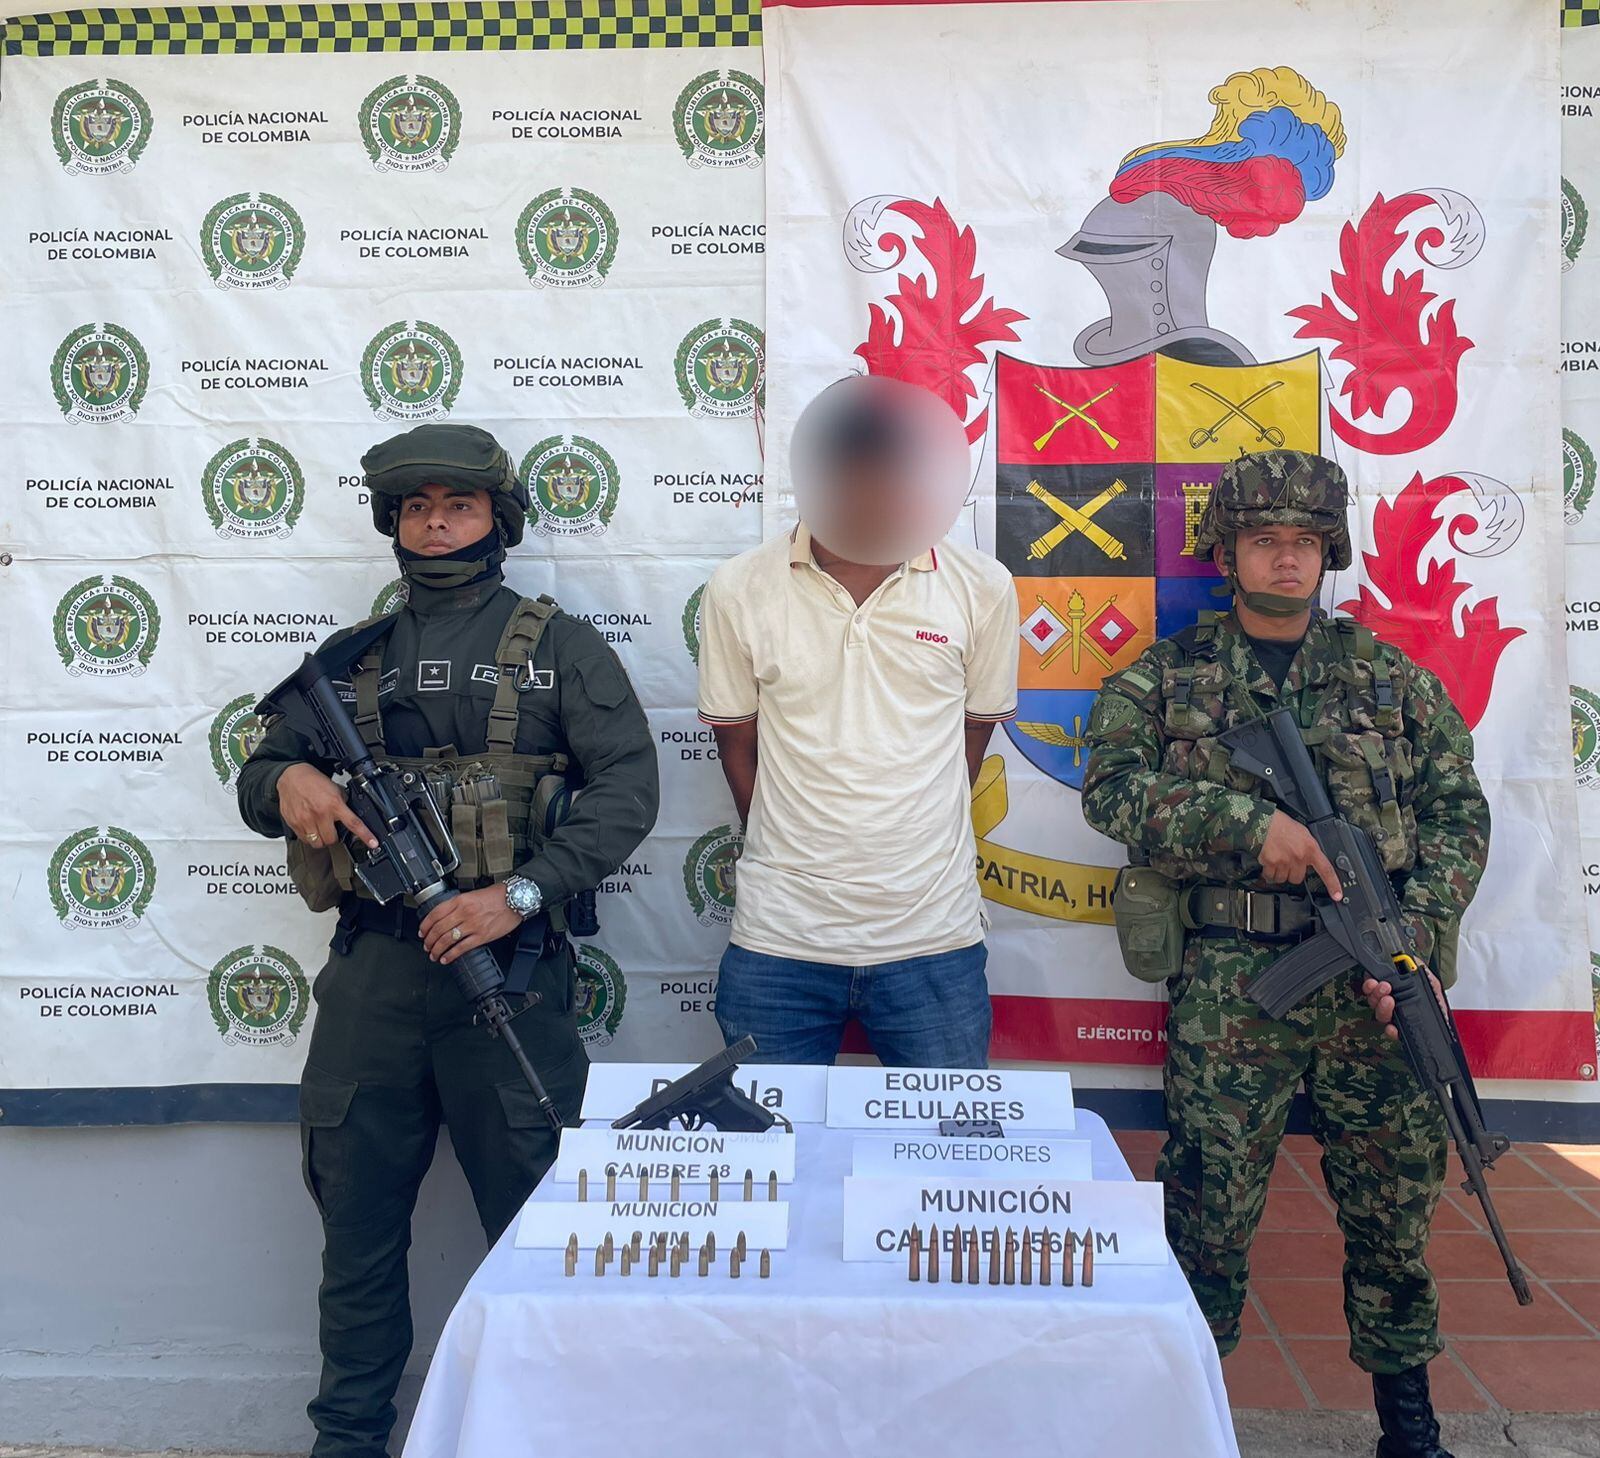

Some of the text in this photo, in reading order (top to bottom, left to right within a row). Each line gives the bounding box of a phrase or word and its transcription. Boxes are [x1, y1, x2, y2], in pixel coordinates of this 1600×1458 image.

[118, 94, 140, 131] COLOMBIA
[426, 91, 449, 128] COLOMBIA
[493, 109, 642, 120] POLICÍA NACIONAL
[184, 111, 328, 126] POLICÍA NACIONAL
[203, 130, 310, 143] DE COLOMBIA
[512, 127, 622, 138] DE COLOMBIA
[100, 139, 134, 163] NACIONAL
[412, 137, 446, 160] NACIONAL
[76, 162, 93, 172] DIOS
[100, 160, 124, 172] PATRIA
[386, 159, 404, 170] DIOS
[412, 159, 437, 170] PATRIA
[270, 208, 293, 246] COLOMBIA
[582, 203, 606, 243] COLOMBIA
[652, 223, 766, 237] POLICÍA NACIO
[30, 228, 173, 243] POLICÍA NACIONAL
[341, 227, 488, 240] POLICÍA NACIONAL
[48, 248, 156, 260] DE COLOMBIA
[360, 246, 469, 257] DE COLOMBIA
[672, 243, 765, 254] DE COLOMB
[253, 254, 288, 278] NACIONAL
[568, 252, 602, 276] NACIONAL
[227, 276, 244, 287] DIOS
[253, 276, 278, 288] PATRIA
[541, 275, 559, 286] DIOS
[568, 273, 593, 286] PATRIA
[426, 336, 450, 376] COLOMBIA
[494, 356, 643, 369] POLICÍA NACIONAL
[182, 357, 328, 372] POLICÍA NACIONAL
[202, 377, 308, 389] DE COLOMBIA
[514, 375, 623, 386] DE COLOMBIA
[412, 385, 446, 409] NACIONAL
[386, 407, 404, 418] DIOS
[412, 408, 437, 419] PATRIA
[268, 454, 293, 494] COLOMBIA
[654, 471, 716, 485] POLICÍA
[27, 477, 174, 491] POLICÍA NACIONAL
[46, 496, 156, 508] DE COLOMBIA
[674, 492, 764, 503] DE COLOMB
[255, 502, 291, 527] NACIONAL
[228, 525, 246, 536] DIOS
[255, 525, 281, 537] PATRIA
[123, 592, 147, 632] COLOMBIA
[189, 611, 338, 625] POLICÍA NACIONAL
[572, 614, 651, 625] ACIONAL
[206, 632, 316, 642] DE COLOMBIA
[916, 630, 948, 644] HUGO
[107, 640, 143, 665] NACIONAL
[78, 663, 98, 674] DIOS
[106, 663, 135, 674] PATRIA
[28, 730, 182, 744] POLICÍA NACIONAL
[661, 729, 716, 743] POLICÍ
[48, 751, 163, 761] DE COLOMBIA
[681, 749, 702, 760] DE
[119, 843, 143, 884] COLOMBIA
[188, 862, 250, 876] POLICÍA
[207, 882, 298, 894] DE COLOMB
[594, 882, 632, 893] MBIA
[102, 892, 138, 917] NACIONAL
[73, 915, 93, 926] DIOS
[101, 915, 128, 927] PATRIA
[272, 961, 297, 1001] COLOMBIA
[590, 959, 614, 1001] COLOMBIA
[661, 979, 717, 994] POLICÍ
[21, 984, 179, 999] POLICÍA NACIONAL
[41, 1004, 157, 1017] DE COLOMBIA
[681, 1001, 701, 1012] DE
[260, 1009, 295, 1033] NACIONAL
[234, 1032, 252, 1043] DIOS
[259, 1032, 285, 1044] PATRIA
[1077, 1025, 1152, 1042] EJÉRCITO
[886, 1073, 1001, 1092] EQUIPOS
[864, 1100, 1024, 1120] CELULARES
[617, 1135, 724, 1153] MUNICION
[895, 1143, 1050, 1162] PROVEEDORES
[922, 1185, 1070, 1213] MUNICIÓN
[611, 1202, 718, 1217] MUNICION
[876, 1229, 995, 1252] CALBRE
